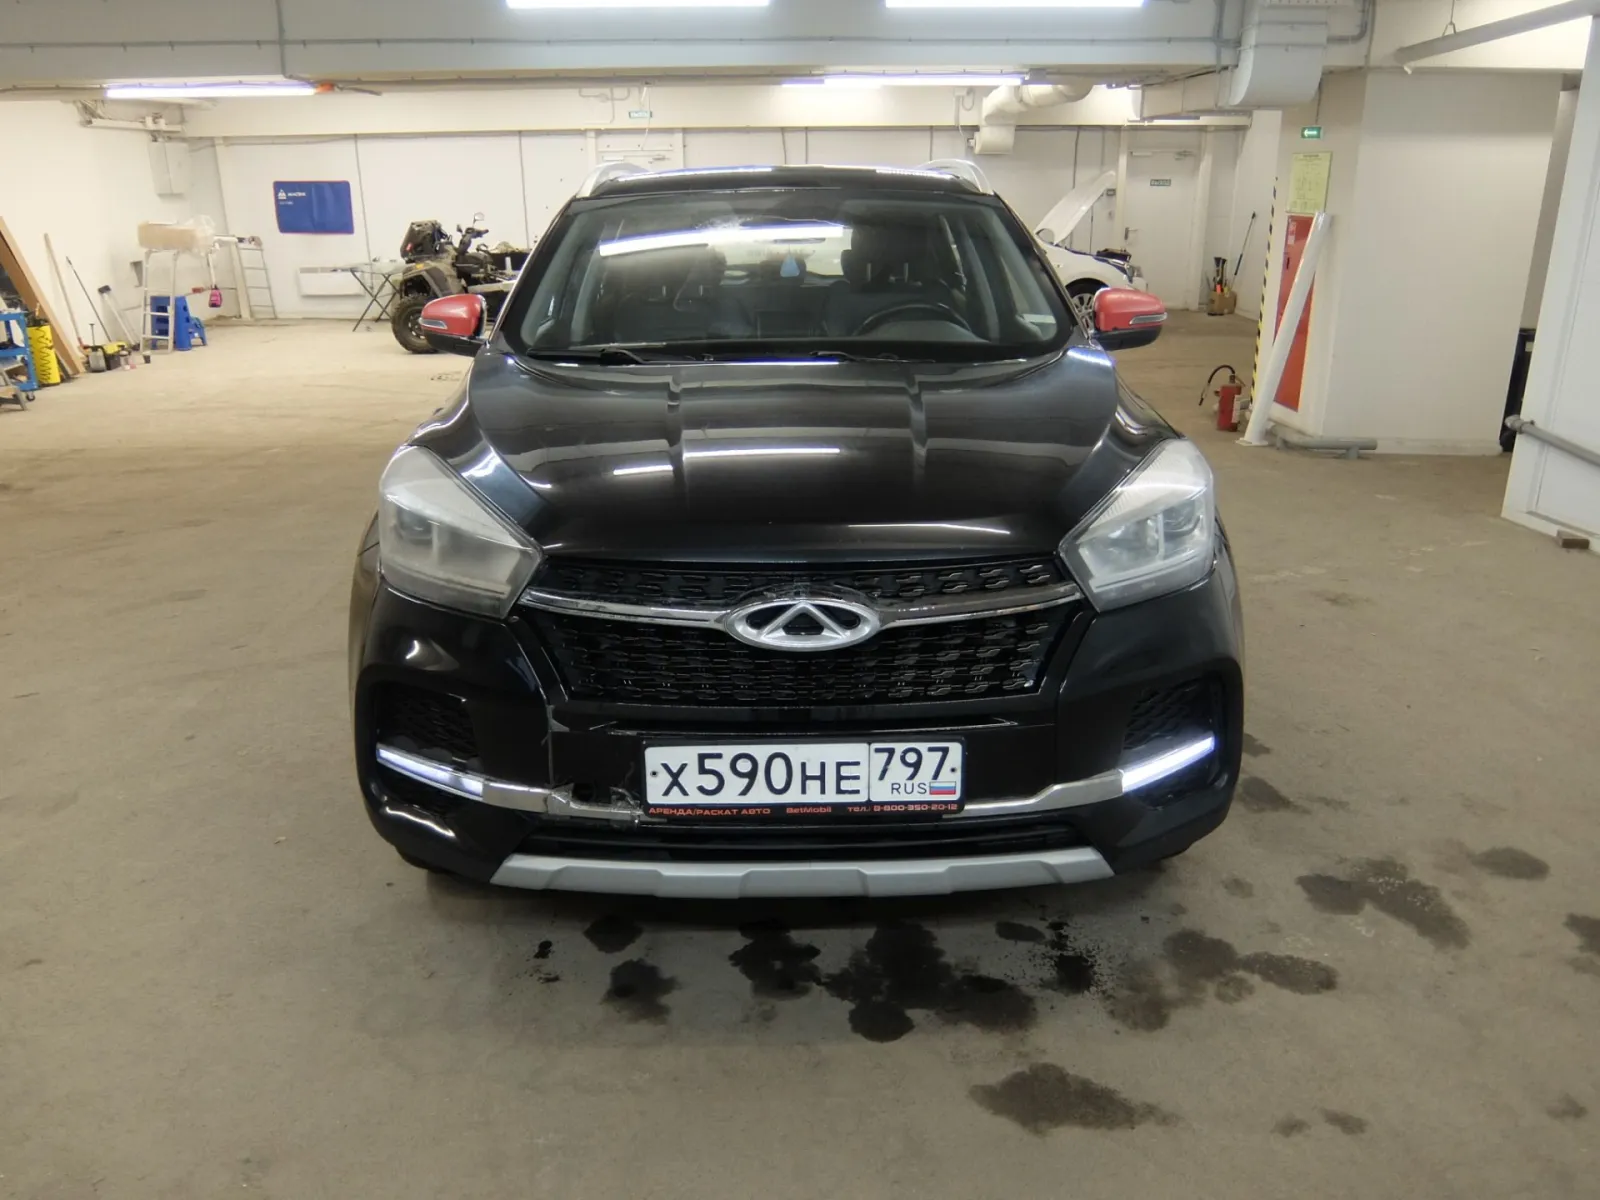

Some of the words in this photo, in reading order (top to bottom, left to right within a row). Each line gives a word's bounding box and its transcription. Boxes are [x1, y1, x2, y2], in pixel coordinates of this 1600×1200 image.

[660, 752, 861, 796] Х590НЕ
[874, 747, 950, 781] 797
[891, 782, 927, 795] RUS
